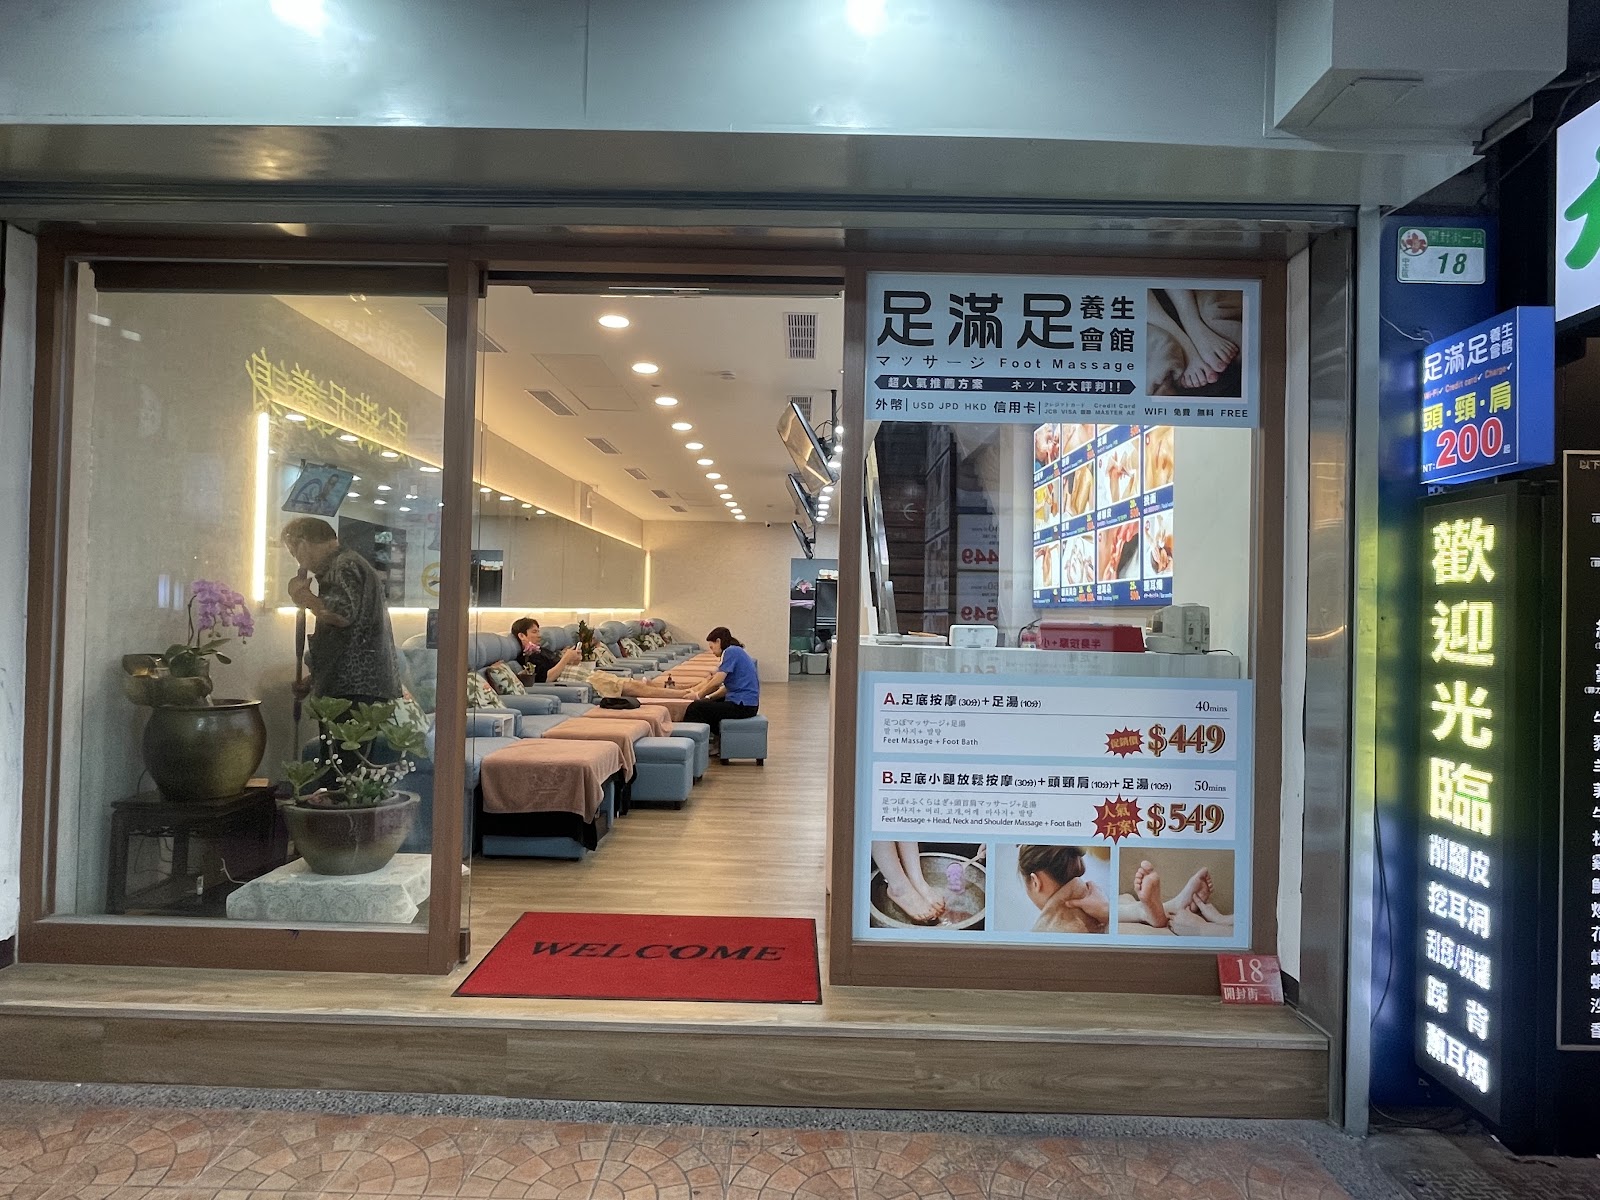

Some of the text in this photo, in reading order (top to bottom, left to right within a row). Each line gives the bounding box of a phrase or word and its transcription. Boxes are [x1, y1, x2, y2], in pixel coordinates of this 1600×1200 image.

[1438, 252, 1467, 274] 18
[1080, 295, 1135, 320] 養生
[877, 290, 1075, 350] 足滿足
[1080, 327, 1135, 352] 會館
[876, 355, 1135, 372] マッサージ Foot Massage
[1424, 333, 1489, 385] 足滿足
[888, 376, 984, 390] 超人氣推薦方案
[912, 402, 934, 410] USD
[938, 402, 959, 410] JPD
[964, 403, 987, 411] HKD
[993, 401, 1036, 414] 信用卡
[1144, 407, 1167, 416] WIFI
[1220, 409, 1248, 418] FREE
[1436, 417, 1504, 469] 200
[1429, 517, 1496, 836] 歡迎光臨
[883, 736, 899, 744] Feet
[901, 737, 933, 746] Massage
[961, 738, 979, 746] Bath
[1148, 723, 1226, 758] $449
[881, 815, 896, 823] Feet
[897, 816, 925, 825] Massage
[932, 817, 951, 825] Head,
[952, 817, 969, 825] Neck
[984, 818, 1013, 826] Shoulder
[1014, 819, 1043, 827] Massage
[1067, 820, 1082, 828] Bath
[1102, 803, 1130, 820] 人氣
[1147, 803, 1225, 837] $549
[1105, 820, 1137, 836] 方案!
[532, 941, 786, 961] WELCOME
[1236, 958, 1264, 983] 18
